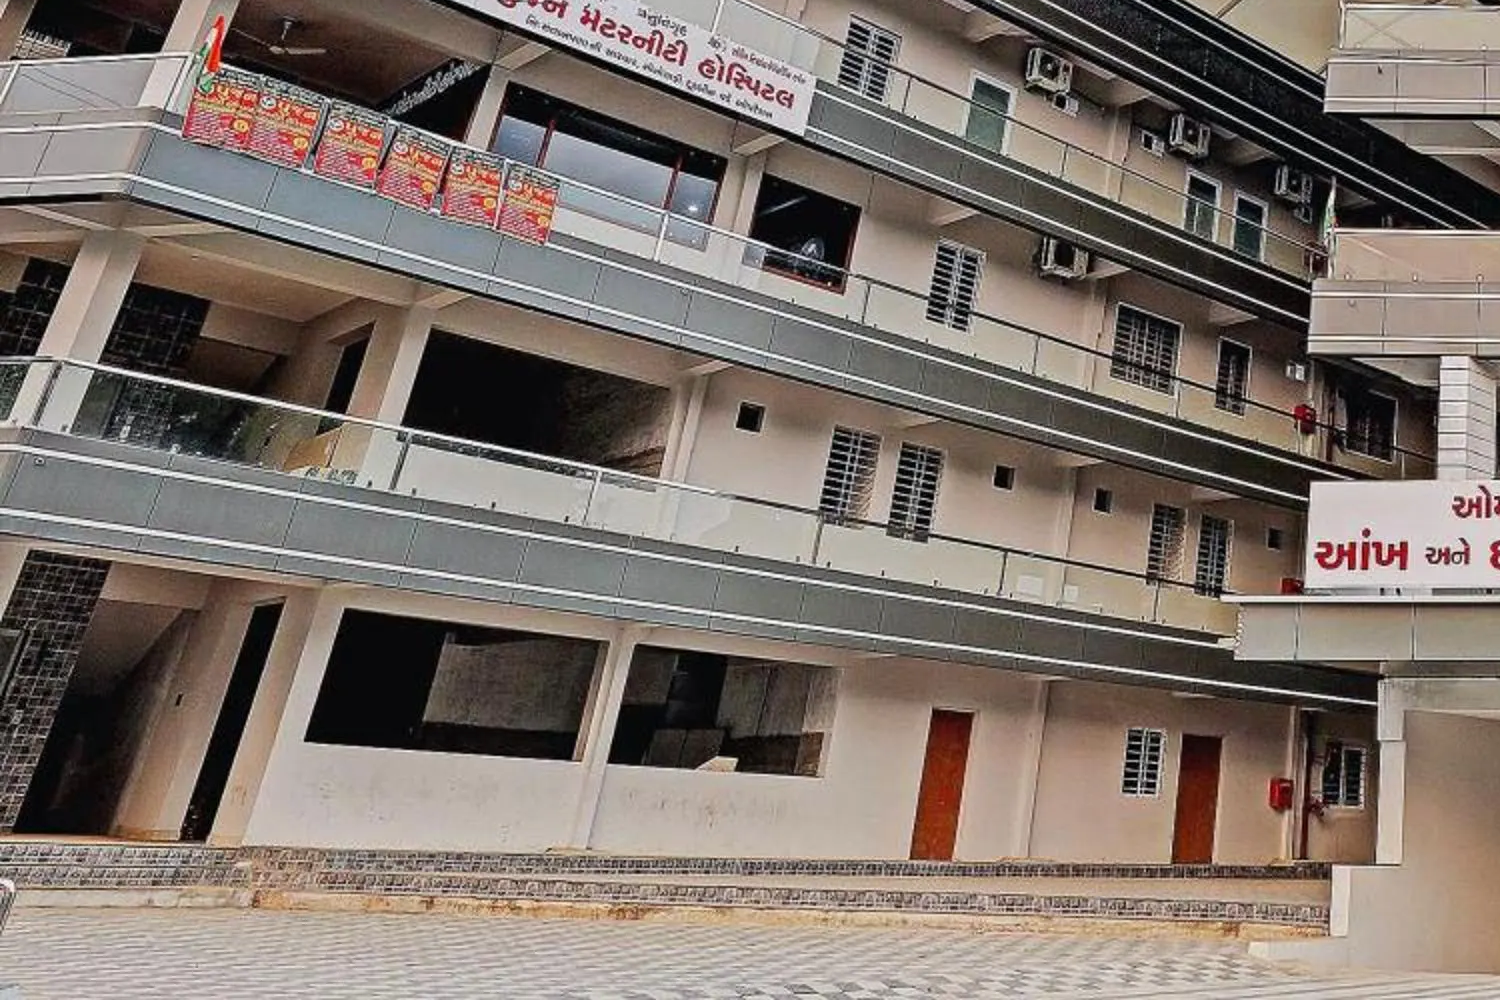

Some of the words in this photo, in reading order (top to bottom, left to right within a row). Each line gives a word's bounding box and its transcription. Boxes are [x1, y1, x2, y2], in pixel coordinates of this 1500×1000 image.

[697, 53, 796, 110] હોસ્પિટલ
[1314, 527, 1409, 571] આંખ
[1425, 537, 1471, 565] અને
